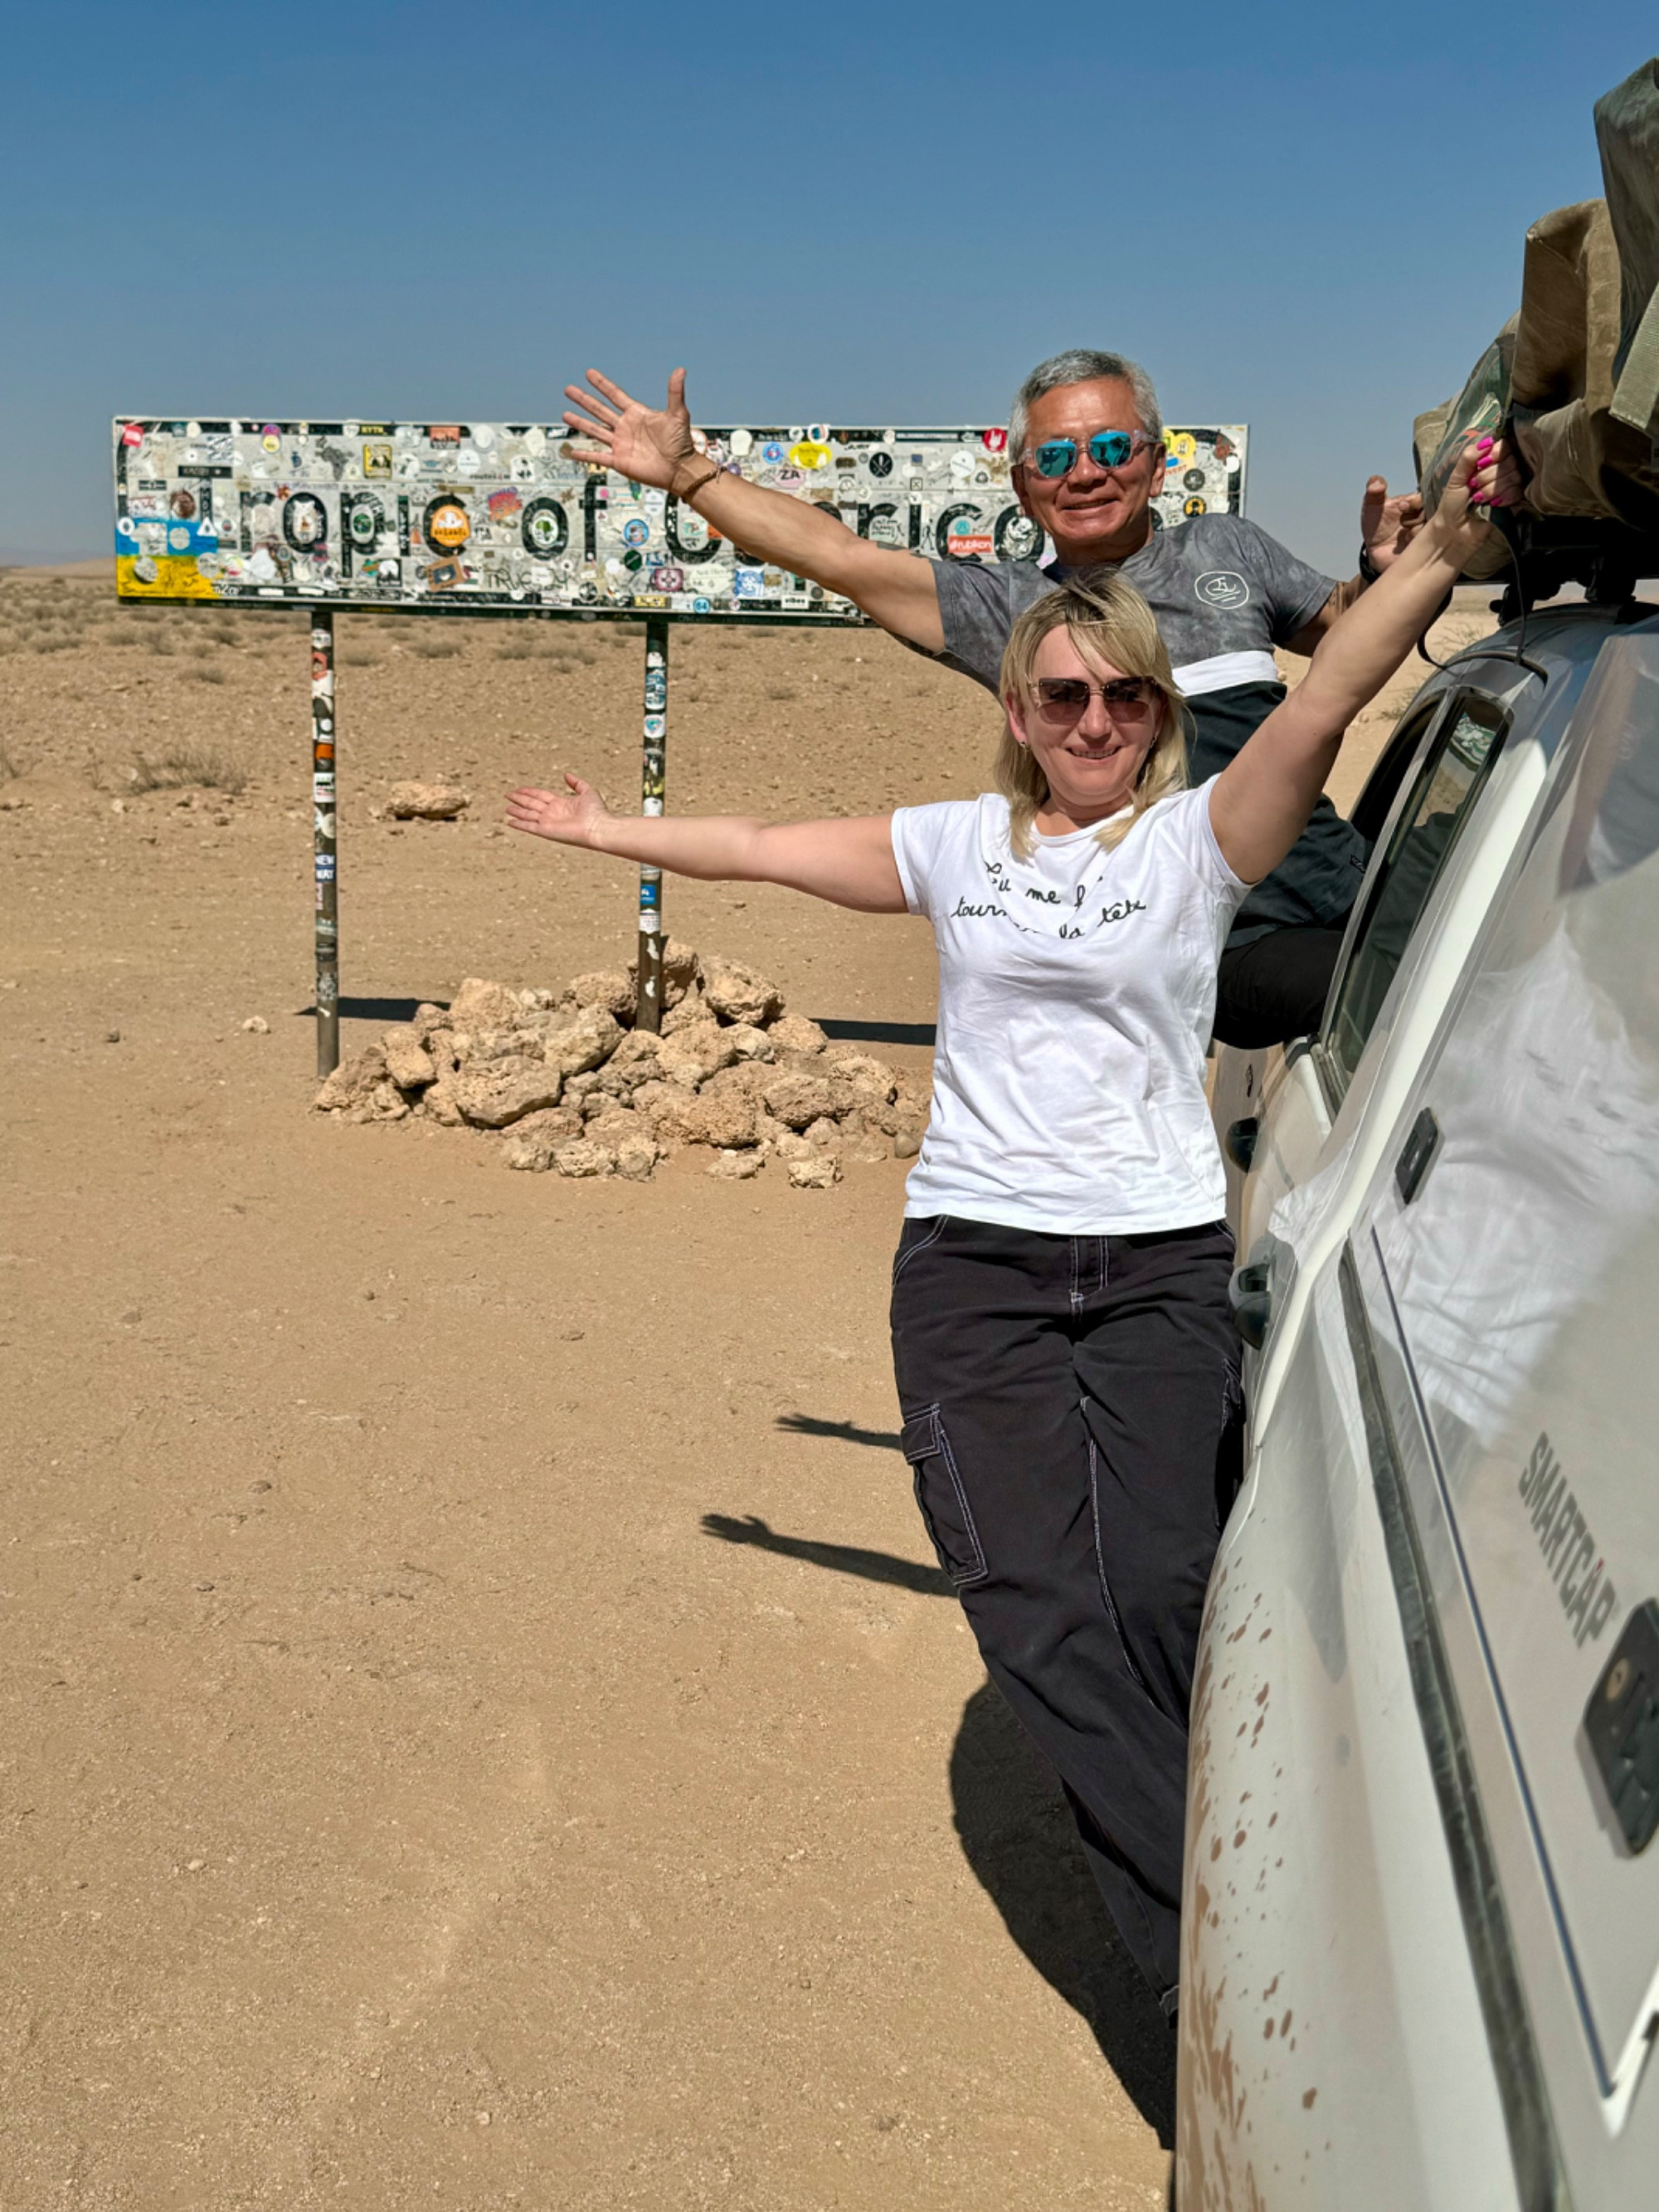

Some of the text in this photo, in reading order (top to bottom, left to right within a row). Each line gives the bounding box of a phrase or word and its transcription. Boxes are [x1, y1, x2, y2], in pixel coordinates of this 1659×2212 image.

[178, 465, 469, 579] Tropic
[522, 471, 611, 563] of
[663, 480, 1164, 567] Crico
[1025, 887, 1061, 904] me
[1518, 1430, 1616, 1649] SMARTCAP
